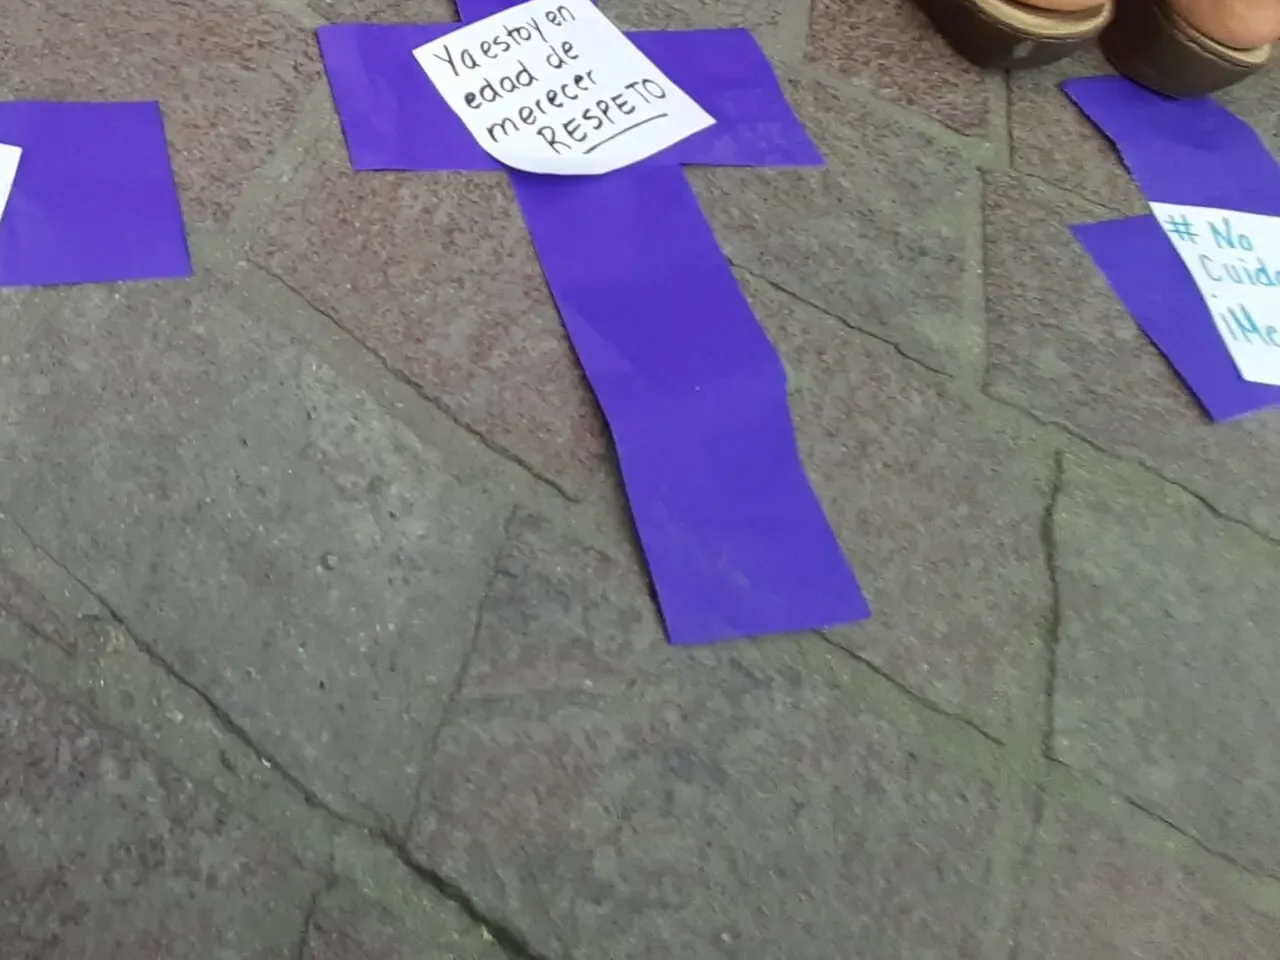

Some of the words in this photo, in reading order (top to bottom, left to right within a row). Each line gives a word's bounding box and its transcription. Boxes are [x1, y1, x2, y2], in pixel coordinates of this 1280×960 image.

[432, 44, 481, 77] Ya
[480, 17, 549, 59] estoy
[545, 4, 576, 27] en
[464, 59, 539, 110] edad
[545, 39, 580, 69] de
[486, 69, 598, 143] merecer
[536, 78, 667, 155] RESPETO
